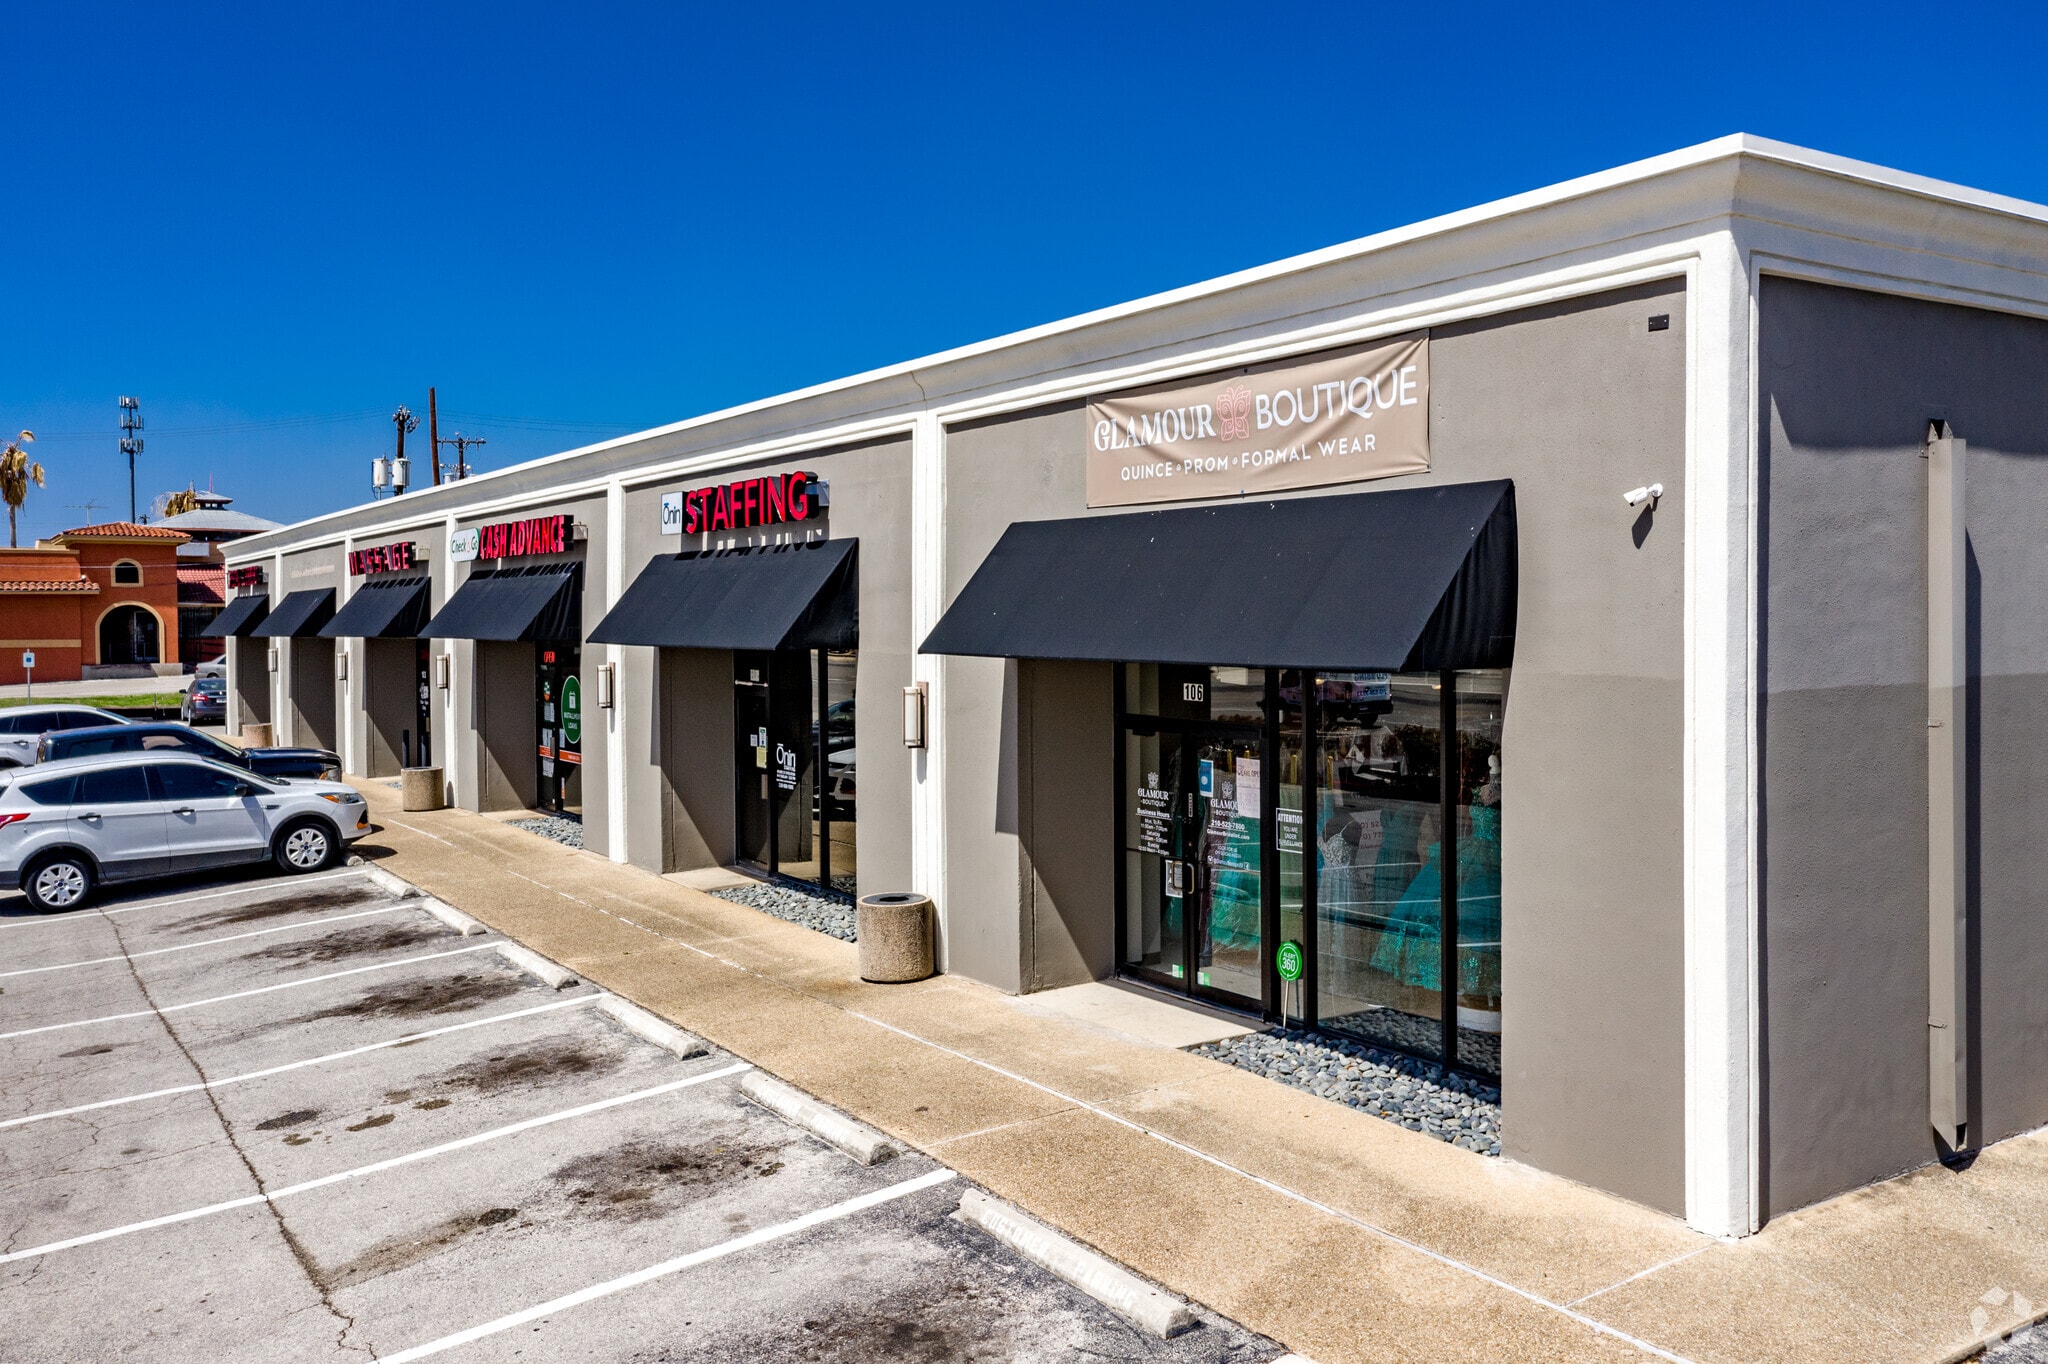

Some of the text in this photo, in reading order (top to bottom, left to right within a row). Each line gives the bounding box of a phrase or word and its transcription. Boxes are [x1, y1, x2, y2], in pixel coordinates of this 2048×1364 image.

[1093, 365, 1418, 451] GLAMOUR BOUTIQUE
[1121, 433, 1377, 481] QUINCE PROM FORMAL WEAR
[685, 471, 809, 535] STAFFING
[480, 515, 565, 561] CASH ADVANCE
[1184, 684, 1203, 701] 106
[1137, 788, 1170, 801] GLAMOUR
[1281, 957, 1296, 973] 360
[1283, 951, 1296, 960] ALERT
